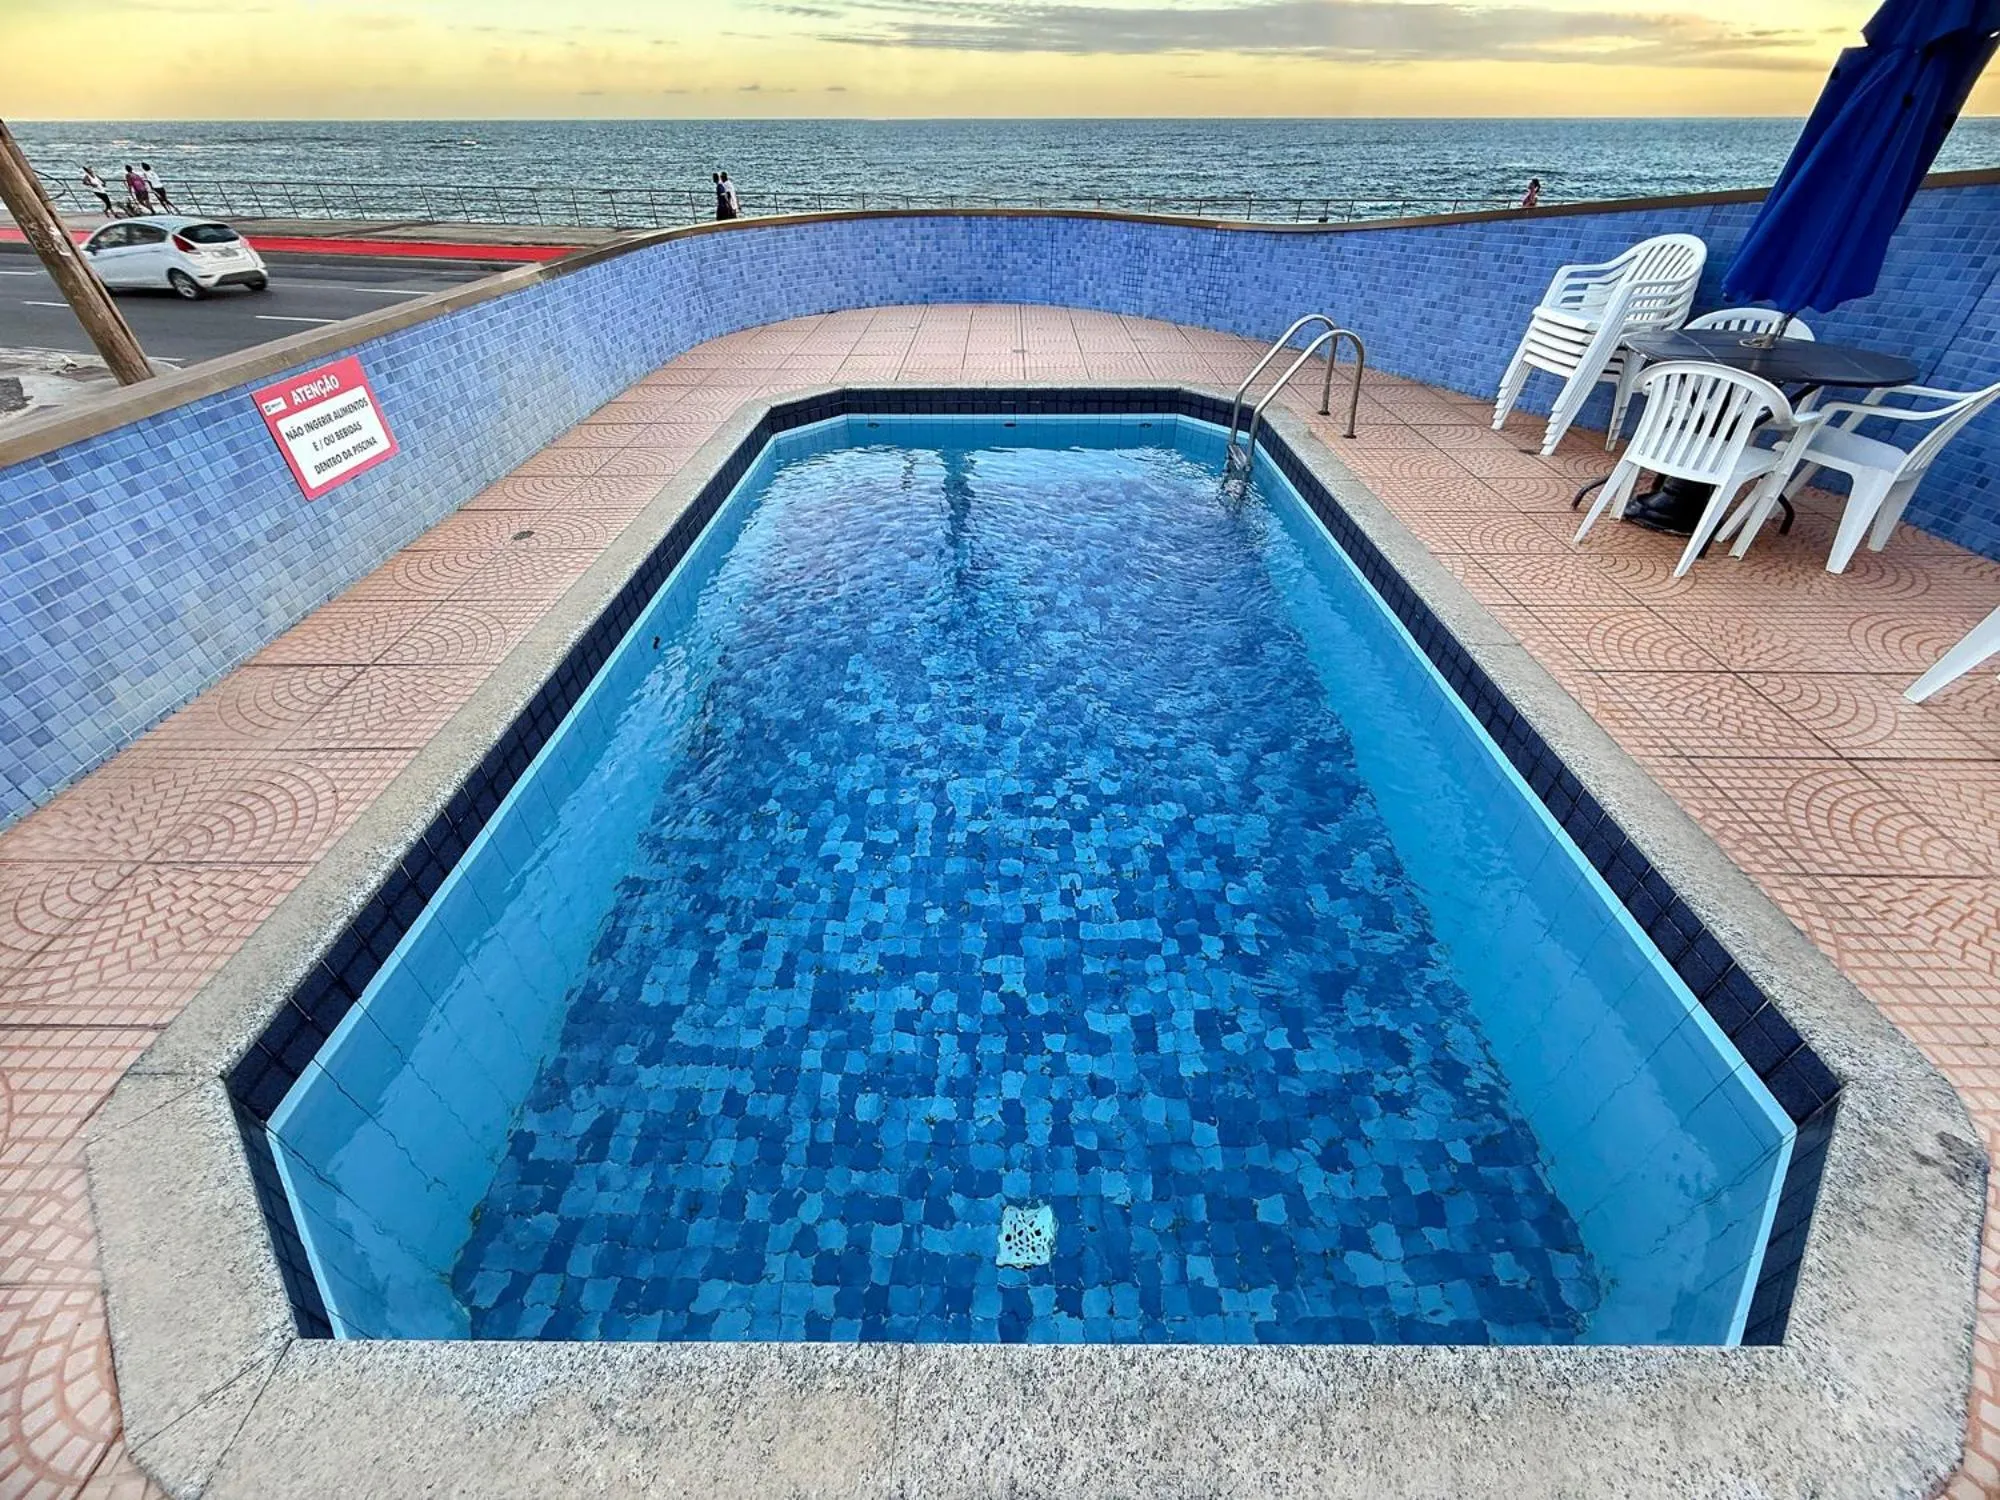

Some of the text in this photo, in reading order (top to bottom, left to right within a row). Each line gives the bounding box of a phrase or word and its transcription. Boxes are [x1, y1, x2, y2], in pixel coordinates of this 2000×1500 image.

[291, 375, 339, 405] ATENÇÃO
[285, 397, 369, 441] NÃO INGERIR ALIMENTOS
[312, 421, 362, 451] E / OU BEBIDAS
[314, 436, 377, 474] DENTRO DA PISCINA
